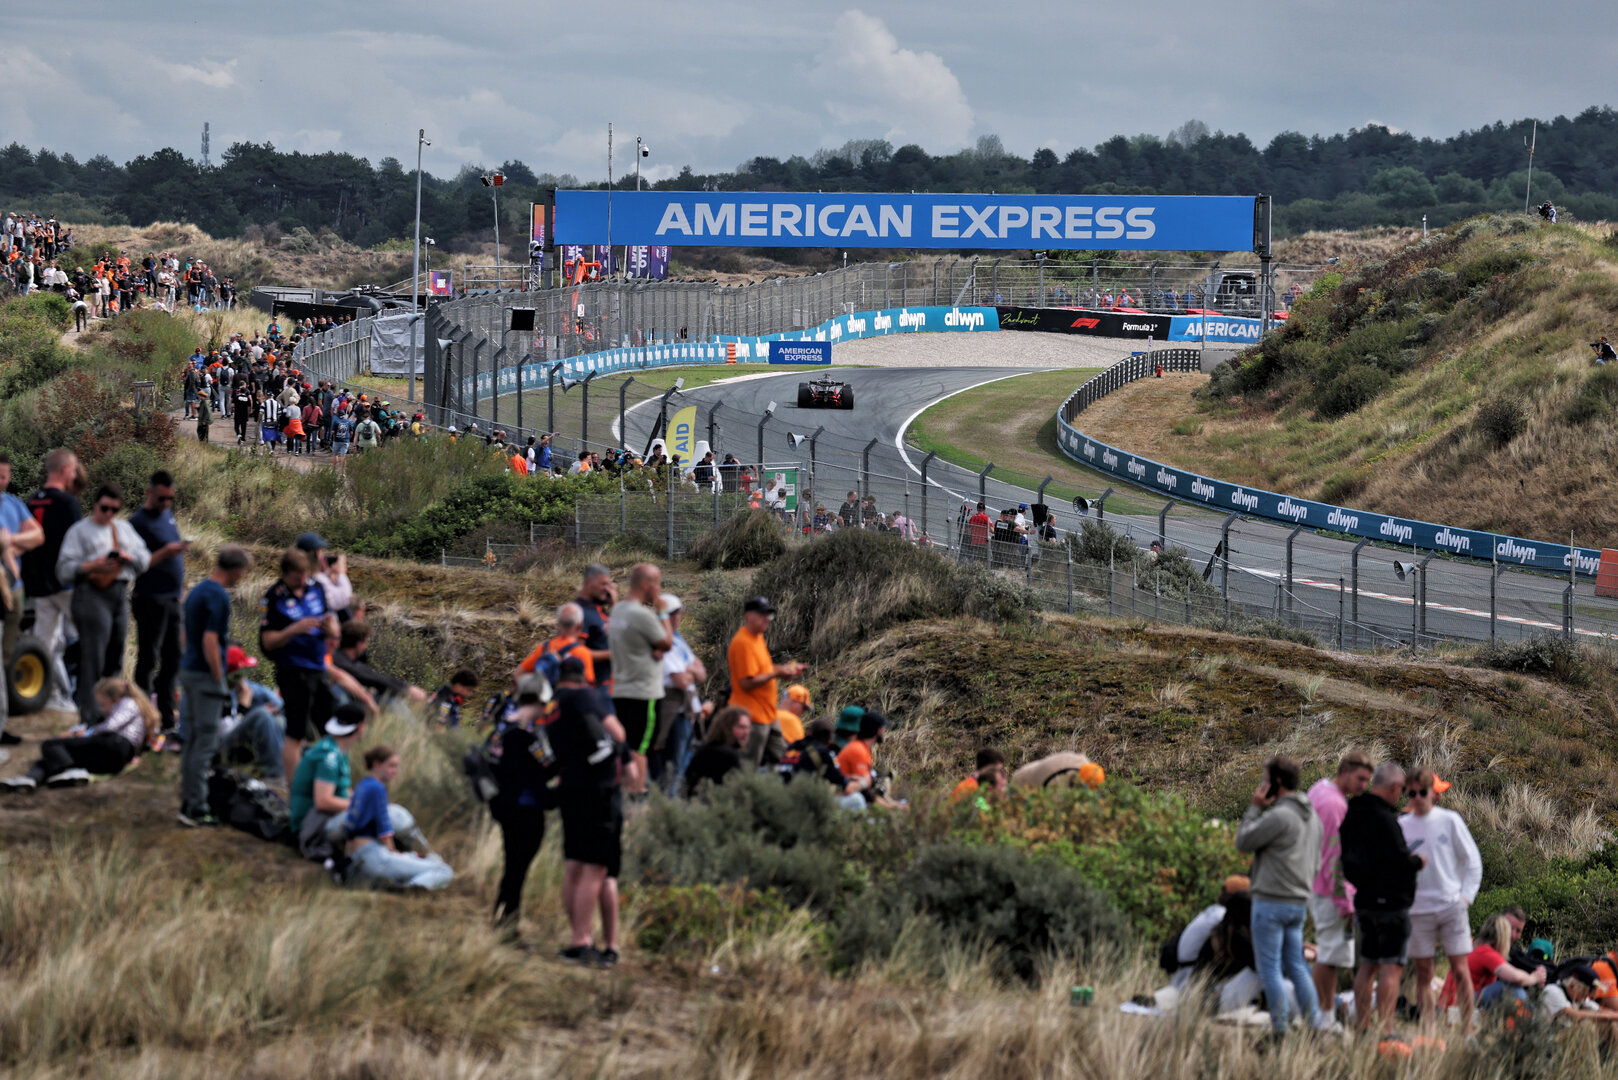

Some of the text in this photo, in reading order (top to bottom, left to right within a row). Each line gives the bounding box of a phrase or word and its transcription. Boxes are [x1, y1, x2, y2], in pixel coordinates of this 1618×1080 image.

[655, 203, 1156, 239] AMERICAN EXPRESS
[899, 308, 926, 331] allwyn
[944, 307, 984, 331] allwyn
[1122, 322, 1150, 332] Formula
[1184, 322, 1260, 338] AMERICAN
[778, 347, 822, 355] AMERICAN
[784, 354, 823, 362] EXPRESS
[675, 423, 690, 453] AID
[1156, 467, 1177, 491] allwyn
[1191, 477, 1215, 502] allwyn
[1231, 488, 1259, 512] allwyn
[1277, 498, 1308, 522] allwyn
[1327, 508, 1359, 532] allwyn
[1379, 518, 1413, 543] allwyn
[1434, 528, 1470, 553] allwyn
[1496, 539, 1537, 564] allwyn
